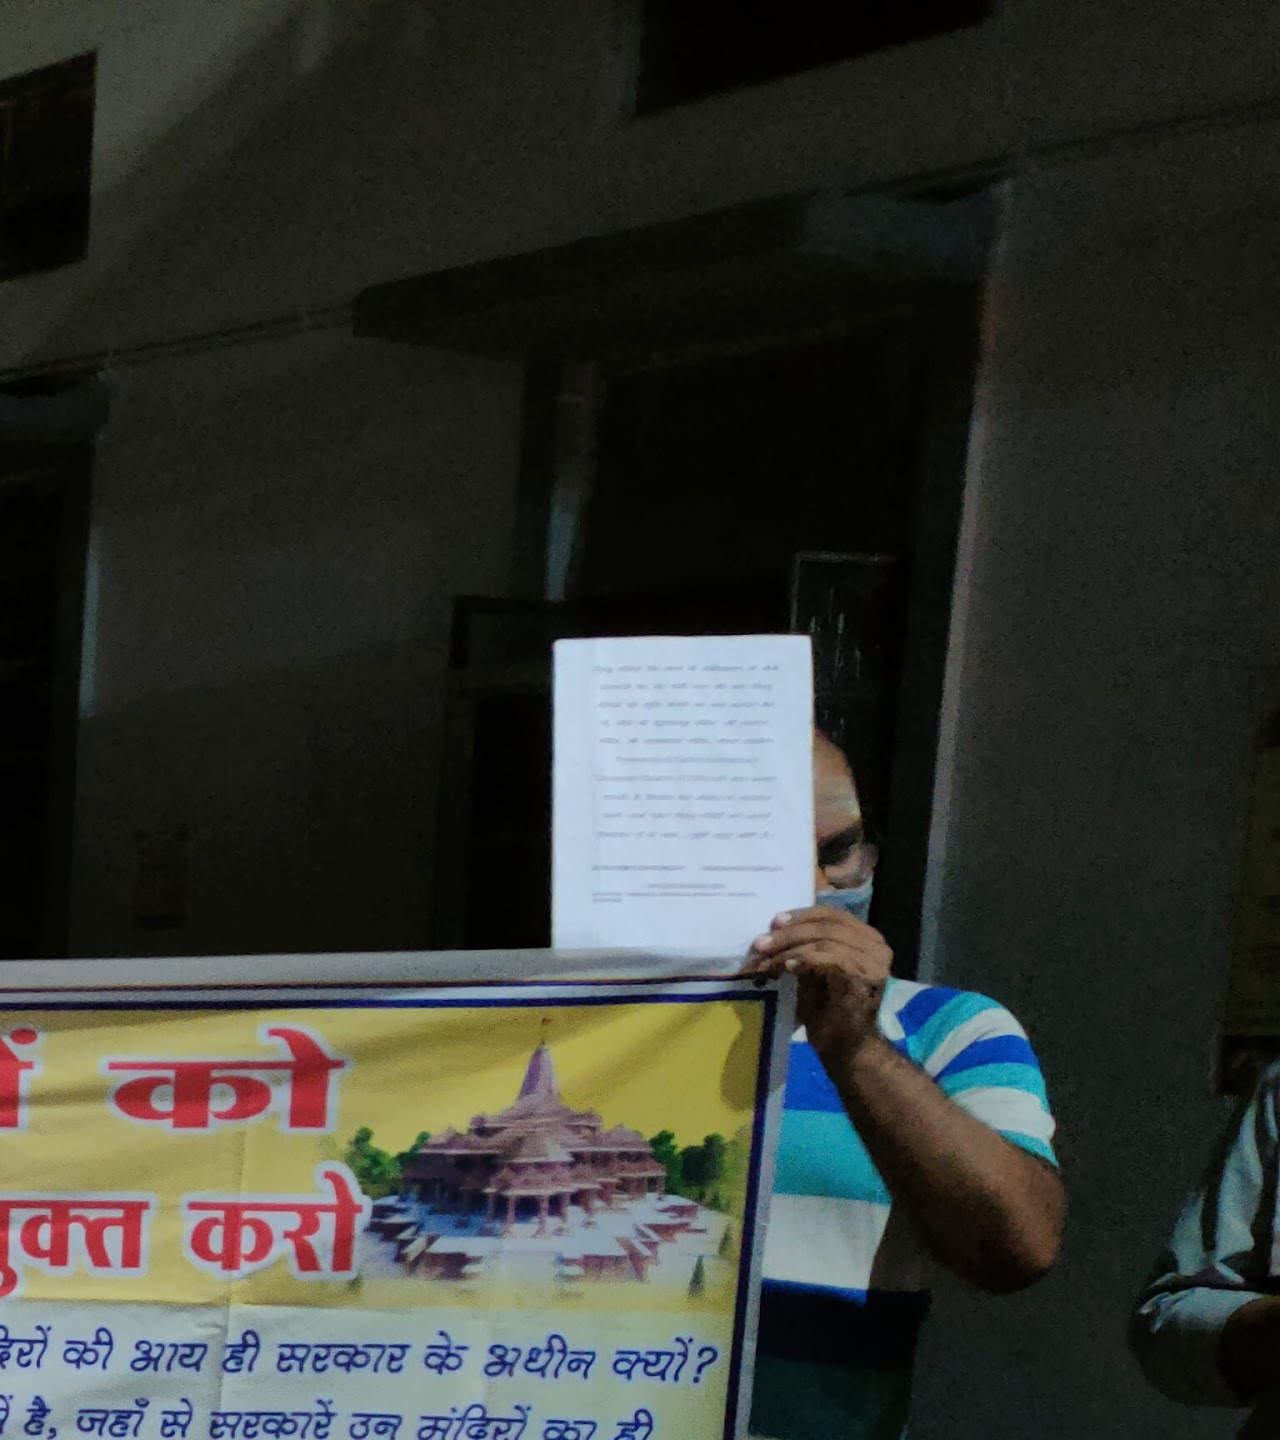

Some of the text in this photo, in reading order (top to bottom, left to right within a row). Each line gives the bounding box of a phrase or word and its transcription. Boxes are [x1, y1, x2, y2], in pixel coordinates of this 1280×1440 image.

[109, 1029, 343, 1128] को
[189, 1172, 361, 1271] करो
[277, 1343, 410, 1373] सरकार
[484, 1335, 596, 1379] अधीन
[613, 1337, 717, 1384] क्यों?
[76, 1397, 150, 1437] जहाँ
[209, 1400, 337, 1440] सरकारें
